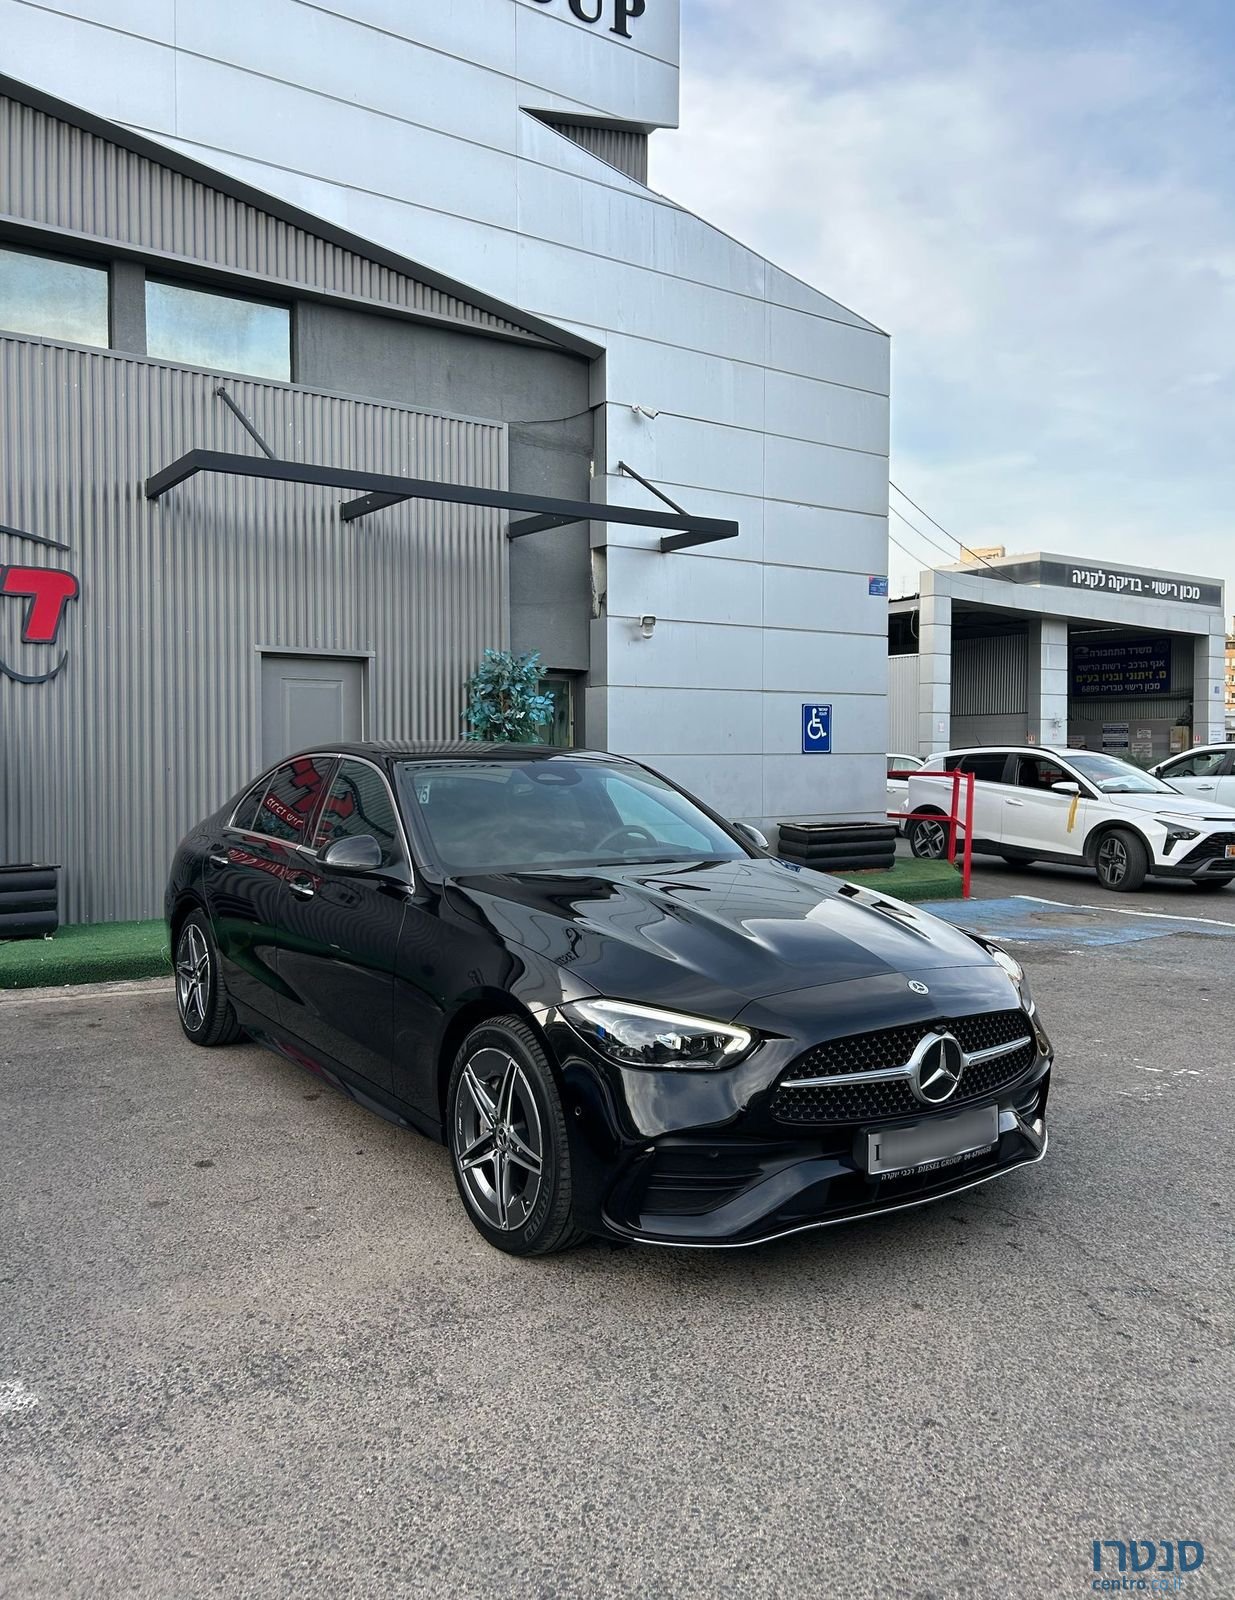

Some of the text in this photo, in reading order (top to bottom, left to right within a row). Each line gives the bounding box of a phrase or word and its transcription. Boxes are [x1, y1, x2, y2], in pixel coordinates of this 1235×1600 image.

[1072, 570, 1106, 588] לקניה
[1108, 574, 1142, 592] בדיקה
[1152, 581, 1178, 597] רישוי
[1180, 585, 1200, 600] מכון
[1090, 646, 1152, 657] משרד התחבורה
[1102, 662, 1121, 670] רשות
[1128, 660, 1148, 669] הרכב
[1150, 659, 1165, 670] אגף
[1102, 672, 1122, 681] ובניו
[1126, 671, 1154, 680] זיתוני
[1144, 682, 1160, 692] מכון
[882, 1171, 900, 1181] יוקרה
[918, 1162, 940, 1173] DIESEL
[940, 1156, 962, 1167] GROUP
